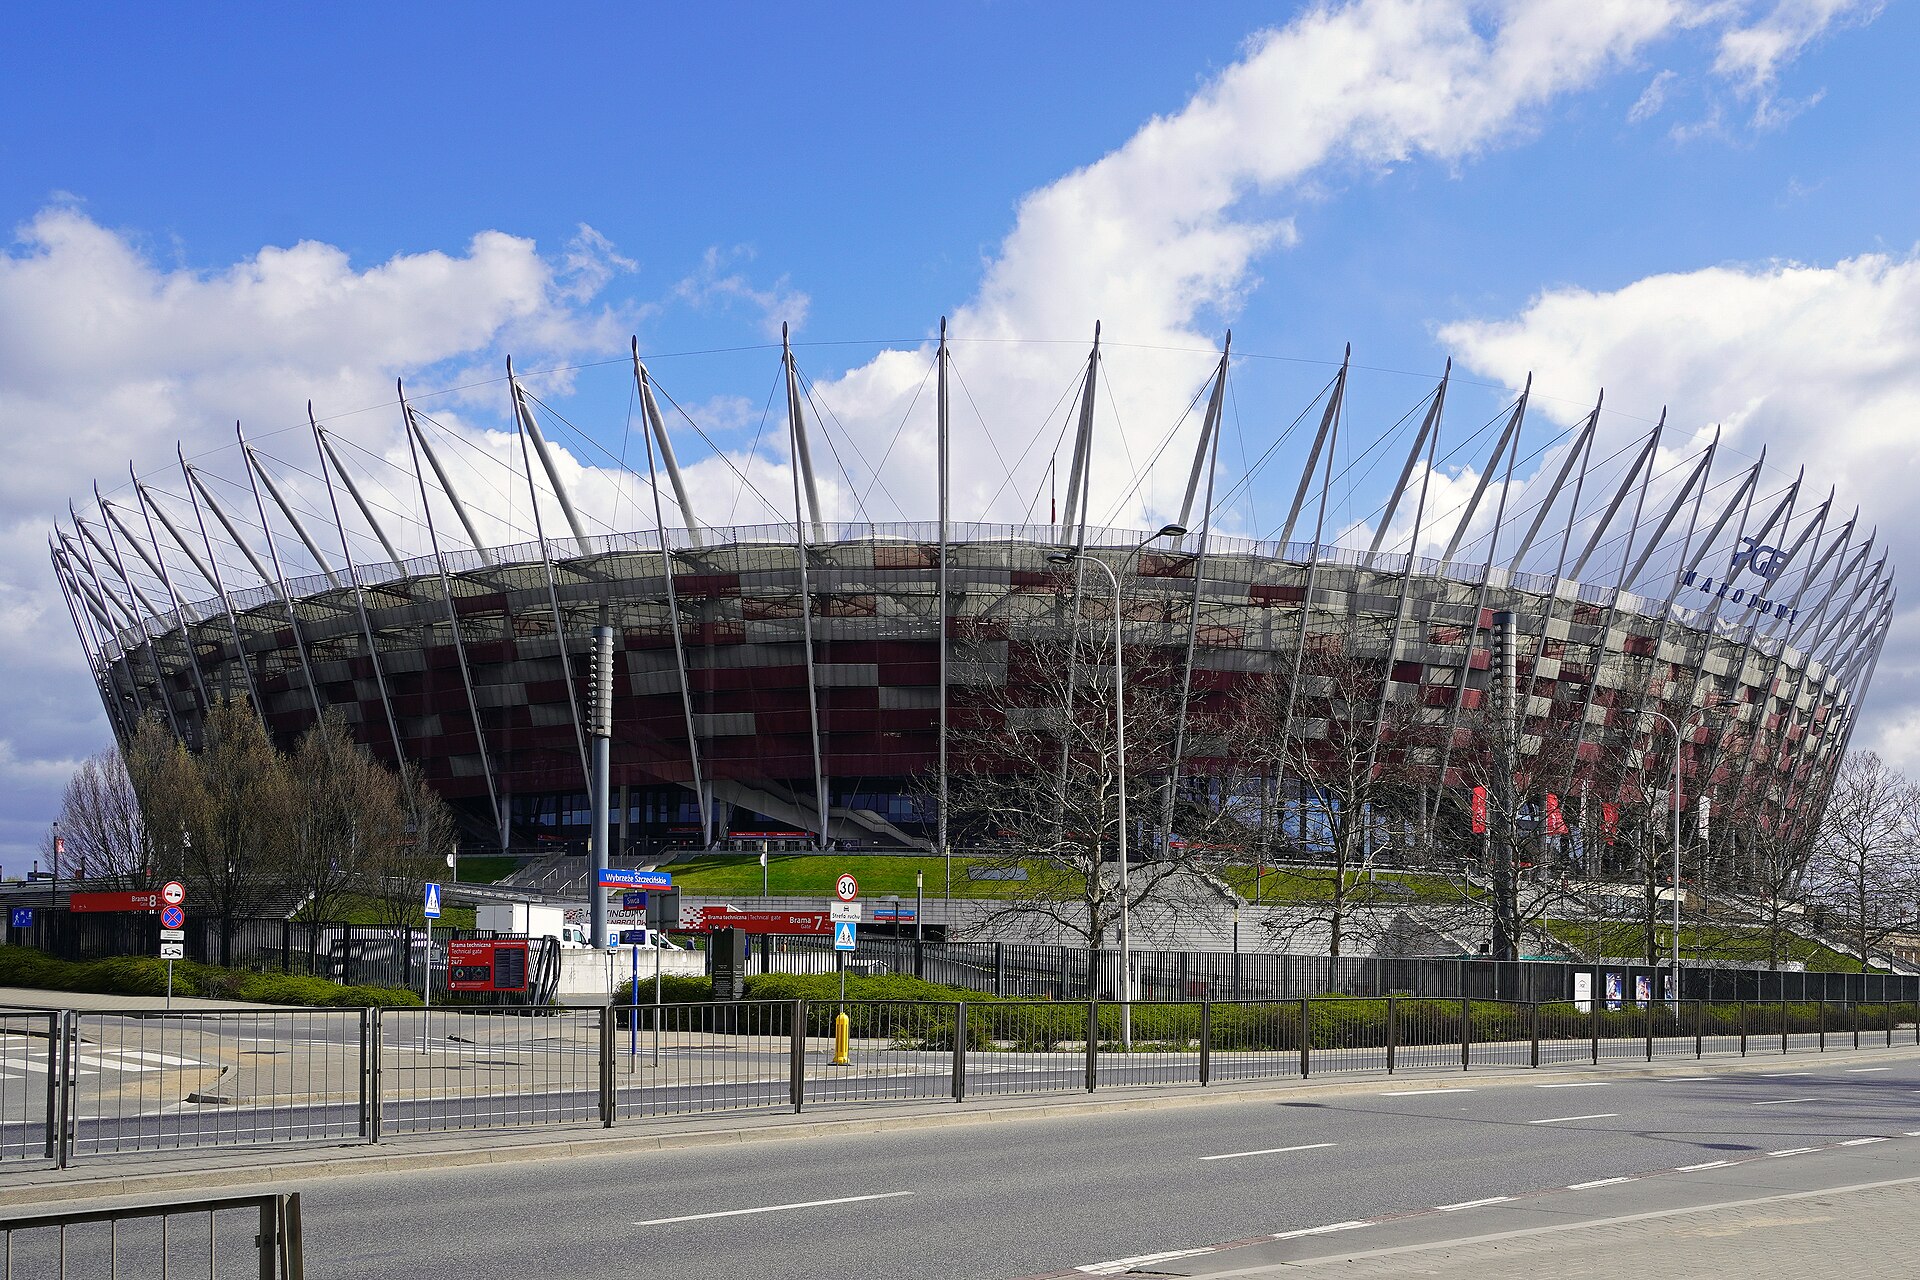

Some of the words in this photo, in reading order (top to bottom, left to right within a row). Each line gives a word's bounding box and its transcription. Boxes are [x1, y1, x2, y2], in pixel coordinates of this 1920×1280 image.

[1732, 536, 1788, 581] PGE
[1682, 570, 1800, 624] NARODOWY
[606, 874, 634, 883] Wybrzeże
[635, 876, 666, 884] Szczecińskie
[839, 881, 855, 895] 30
[149, 895, 156, 907] 8
[814, 916, 822, 930] 7
